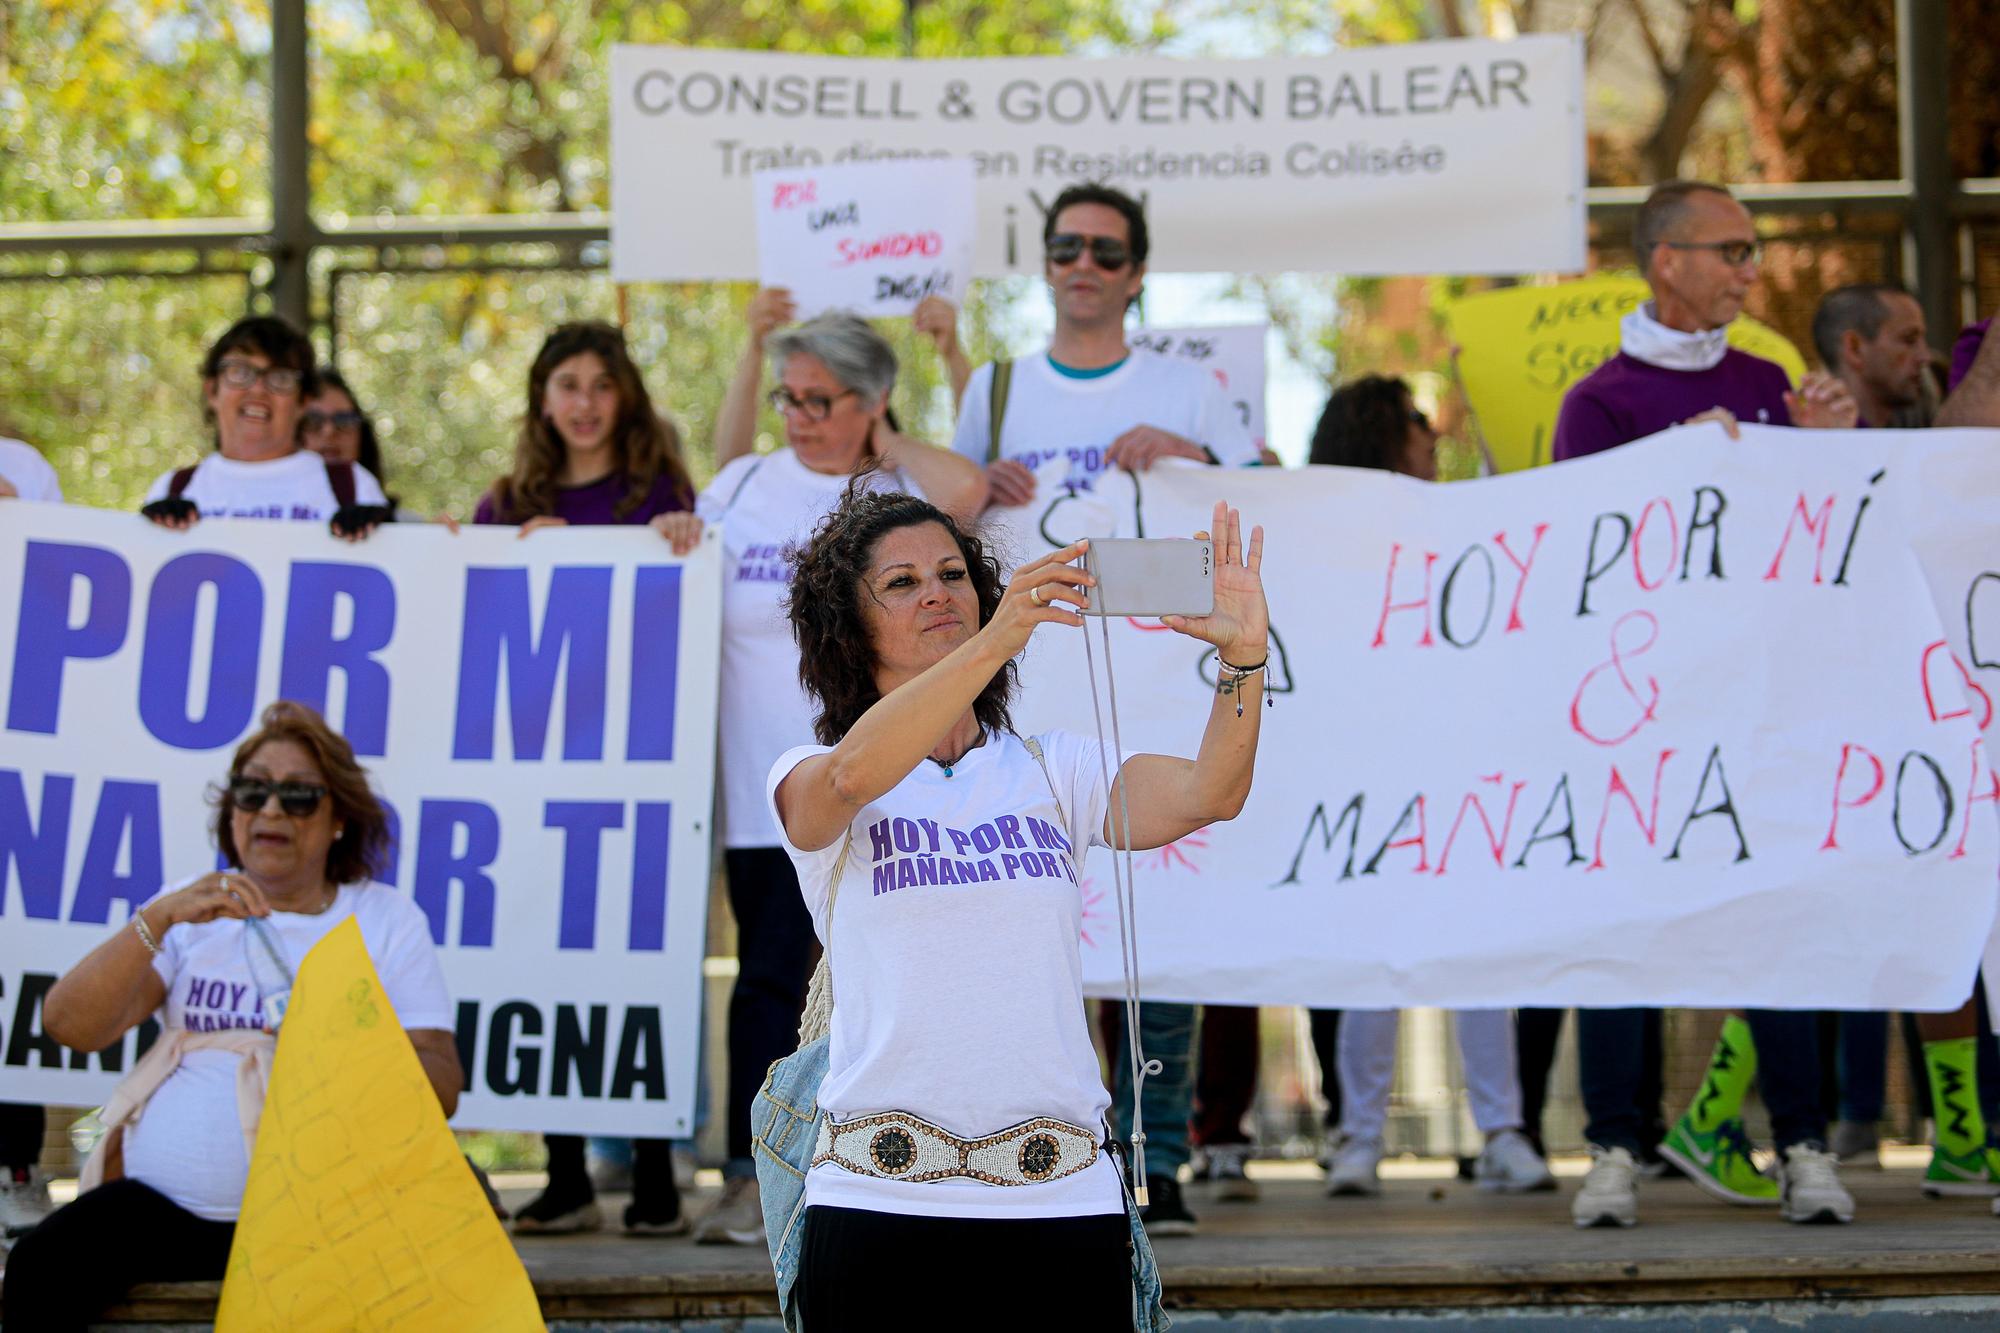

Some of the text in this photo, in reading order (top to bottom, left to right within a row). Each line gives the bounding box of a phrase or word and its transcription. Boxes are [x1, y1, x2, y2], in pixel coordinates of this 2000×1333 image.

[632, 59, 1531, 125] CONSELL & GOVERN BALEAR
[1033, 143, 1271, 178] Residencia
[1371, 468, 1886, 650] HOY POR MÍ
[6, 539, 684, 763] POR MI
[1570, 609, 1659, 747] &
[869, 816, 941, 862] HOY
[946, 814, 1028, 856] POR
[1268, 745, 1751, 889] MAÑANA
[543, 800, 671, 952] TI
[873, 852, 1001, 896] MAÑANA
[1001, 852, 1062, 880] POR
[185, 976, 247, 1012] HOY
[453, 1000, 668, 1101] IGNA
